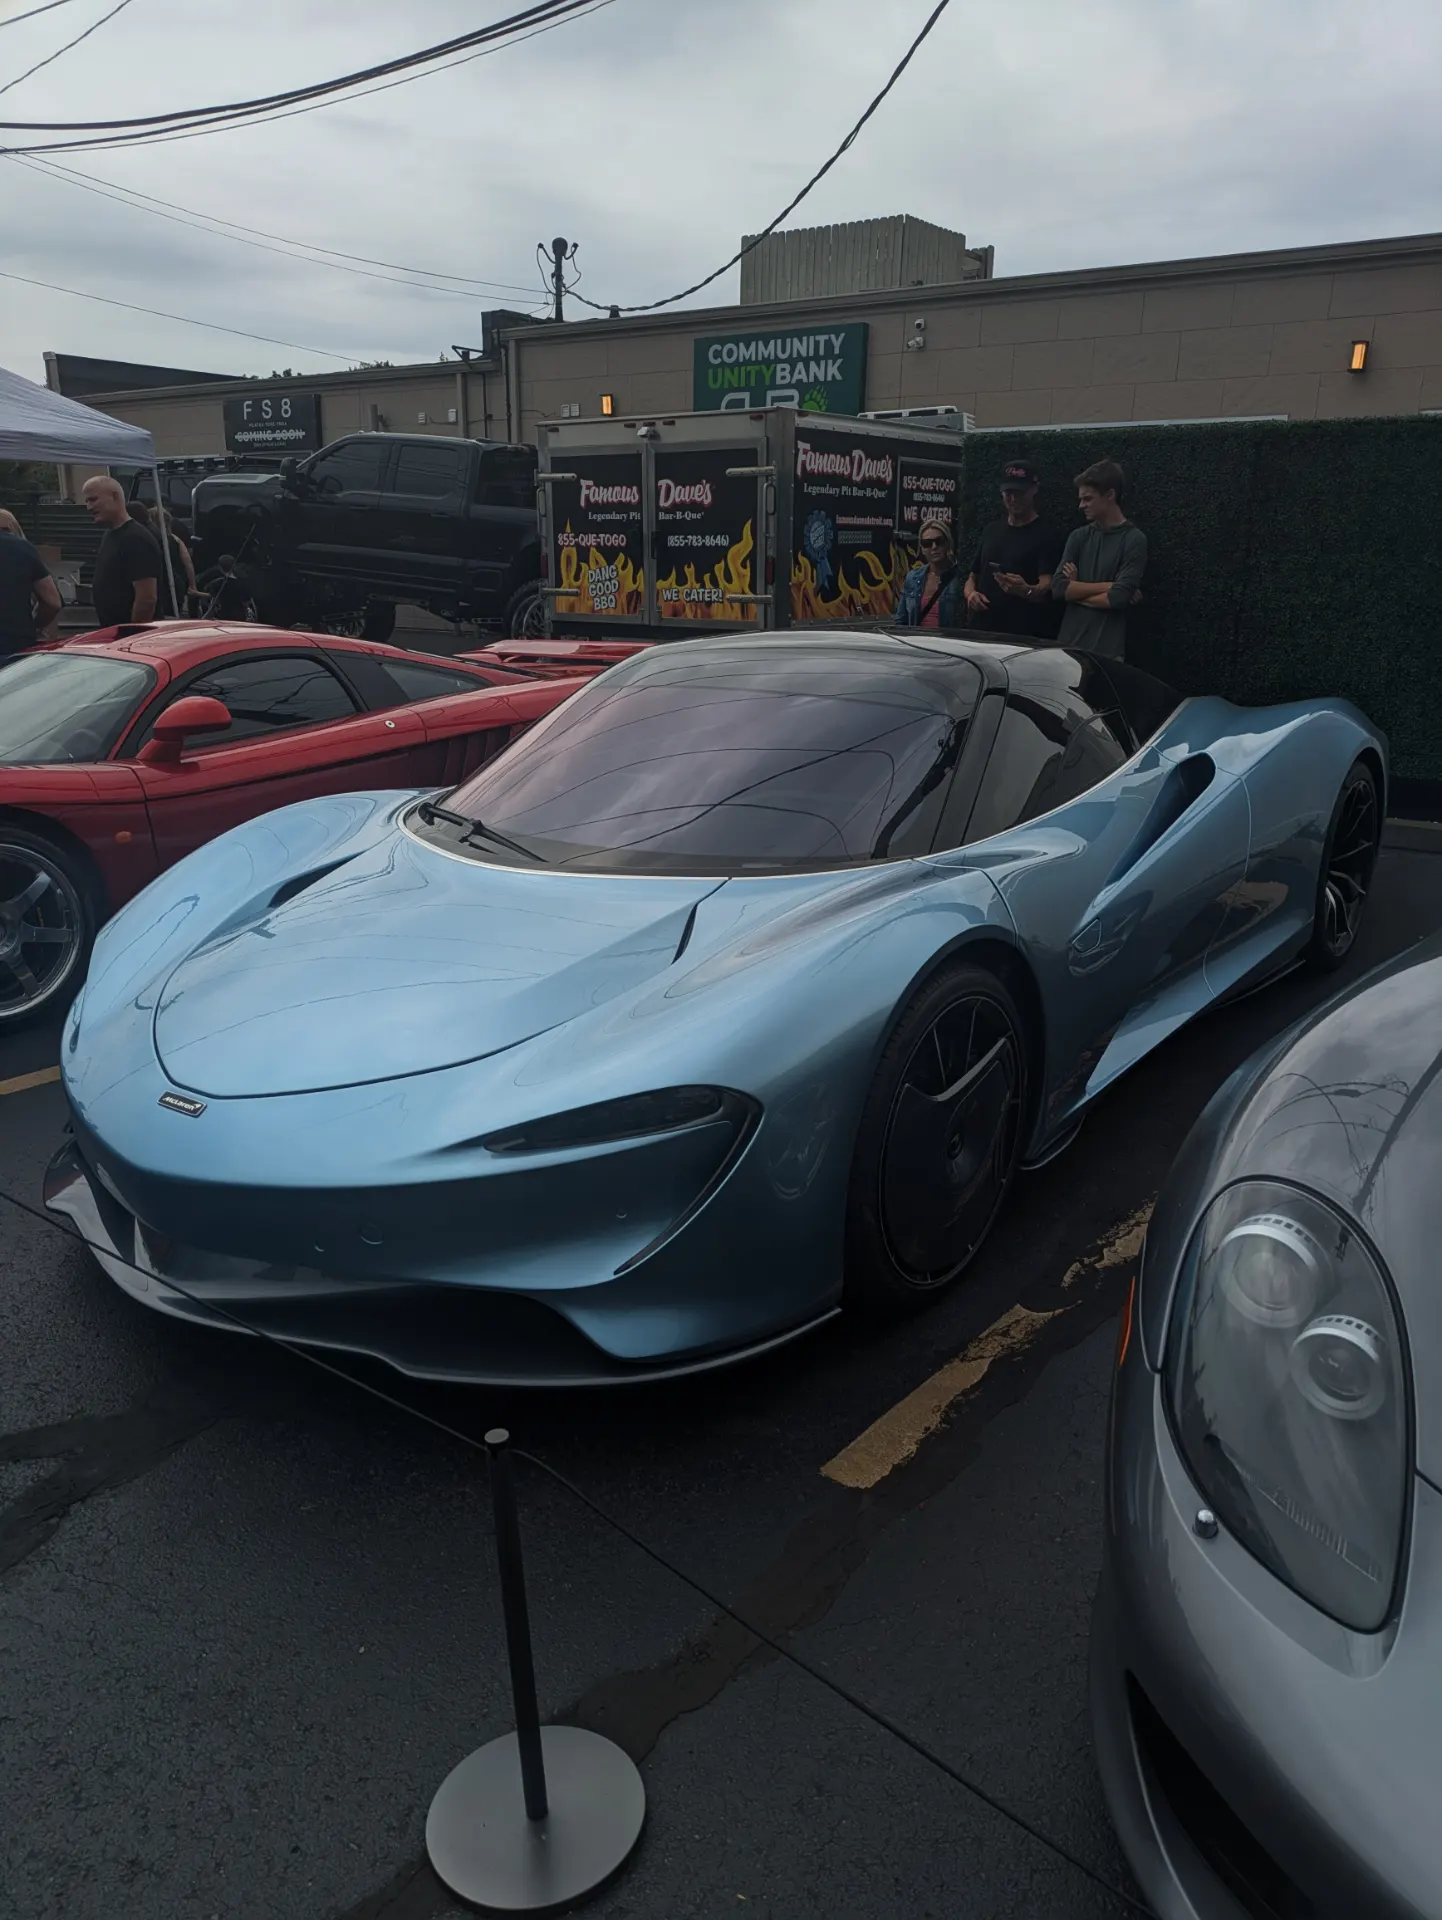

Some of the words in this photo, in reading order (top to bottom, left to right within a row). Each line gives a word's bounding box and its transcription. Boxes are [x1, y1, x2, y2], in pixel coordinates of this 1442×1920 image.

[708, 332, 846, 365] COMMUNITY
[237, 430, 273, 442] COMING
[275, 429, 304, 441] SOON
[797, 440, 851, 478] Famous
[852, 449, 893, 484] Dave's
[803, 483, 840, 497] Legendary
[841, 485, 851, 496] Pit
[902, 475, 956, 492] 855-QUE-TOGO
[580, 479, 640, 508] Famous
[657, 478, 713, 508] Dave's
[588, 511, 628, 522] Legendary
[629, 511, 641, 520] Pit
[903, 506, 917, 521] WE
[920, 506, 952, 523] CATER!
[557, 533, 627, 548] 855-QUE-TOGO
[667, 534, 729, 547] (855-783-8646)
[588, 564, 618, 583] DANG
[588, 580, 619, 597] GOOD
[662, 588, 679, 602] WE
[683, 588, 723, 602] CATER!
[593, 596, 616, 611] BBQ
[162, 1096, 195, 1111] McLaren
